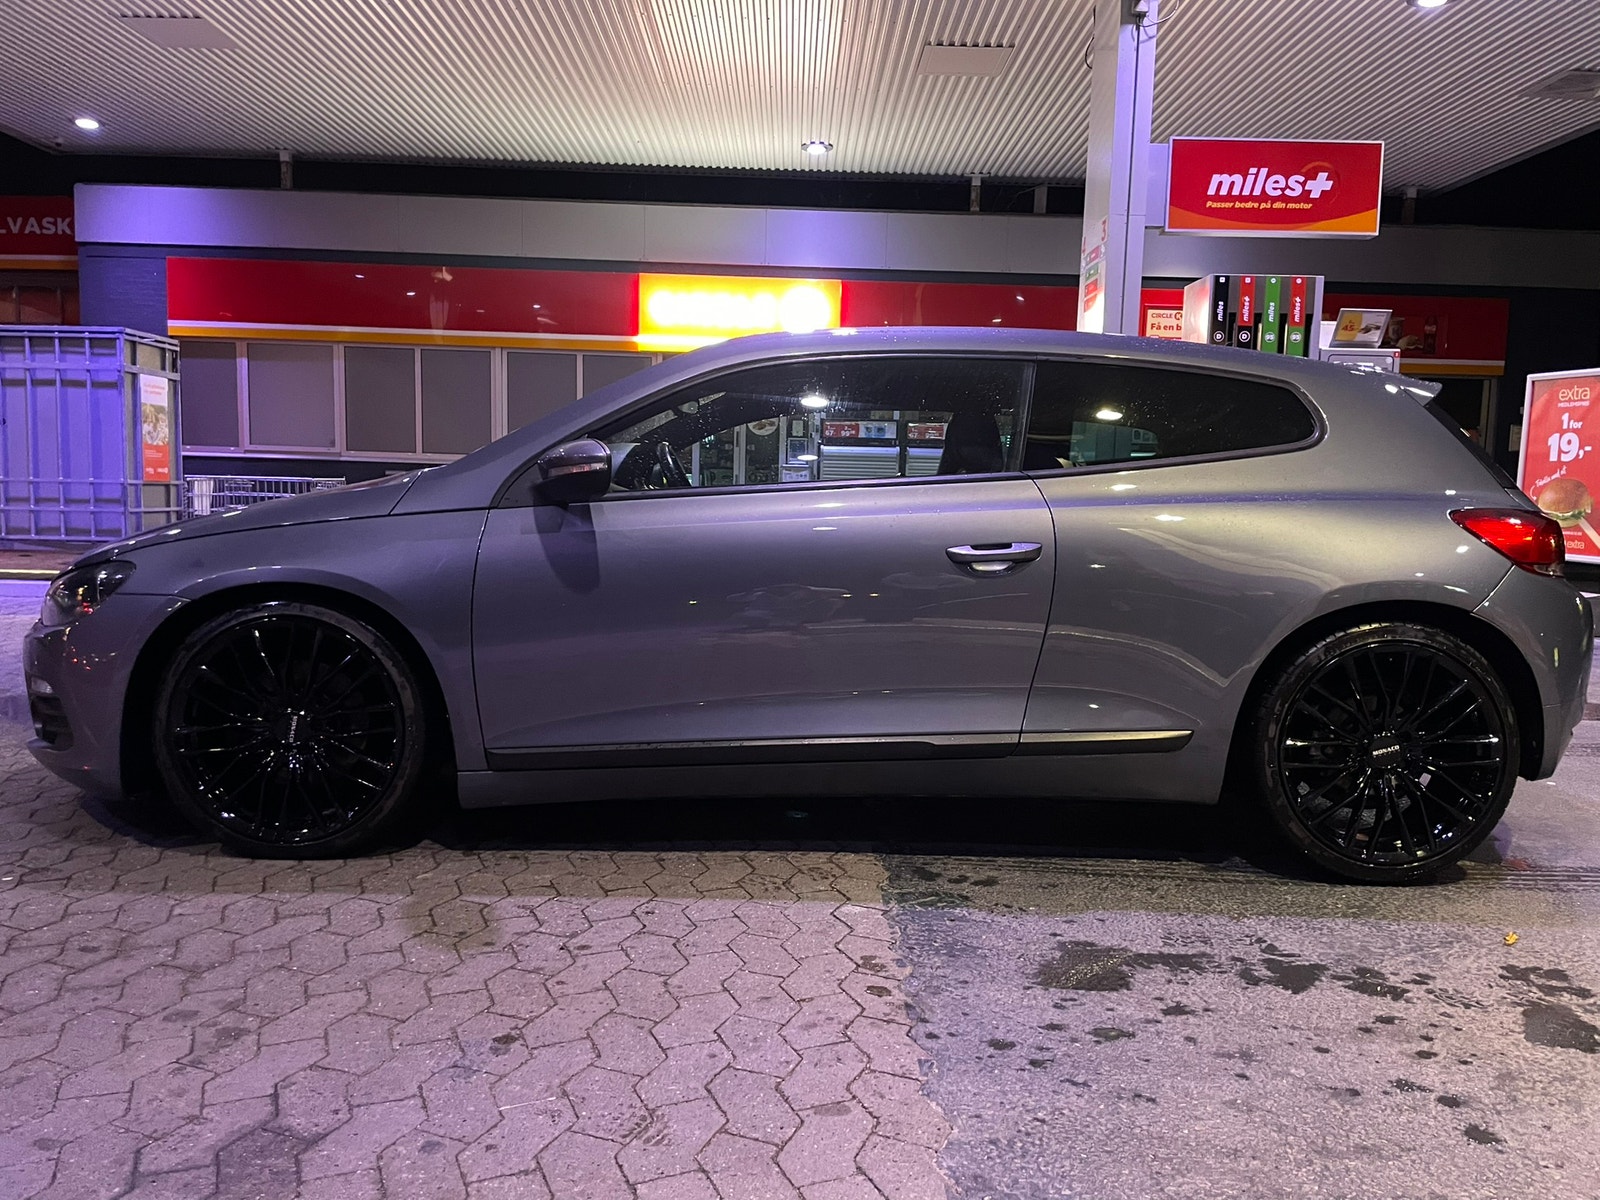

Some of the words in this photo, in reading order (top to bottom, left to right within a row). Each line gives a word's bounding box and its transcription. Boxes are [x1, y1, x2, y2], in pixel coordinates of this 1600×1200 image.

[1206, 167, 1334, 199] miles+
[1205, 200, 1234, 208] Passer
[1234, 200, 1259, 209] bedre
[1260, 200, 1272, 210] på
[1272, 201, 1286, 209] din
[1216, 300, 1224, 321] miles
[1242, 295, 1250, 322] miles+
[1267, 301, 1275, 322] miles
[1294, 296, 1302, 322] miles+
[1150, 322, 1161, 331] Få
[1558, 385, 1590, 400] extra
[1561, 412, 1569, 429] 1
[1569, 420, 1583, 429] for
[1547, 432, 1592, 462] 19,-
[1372, 745, 1400, 755] MONACO
